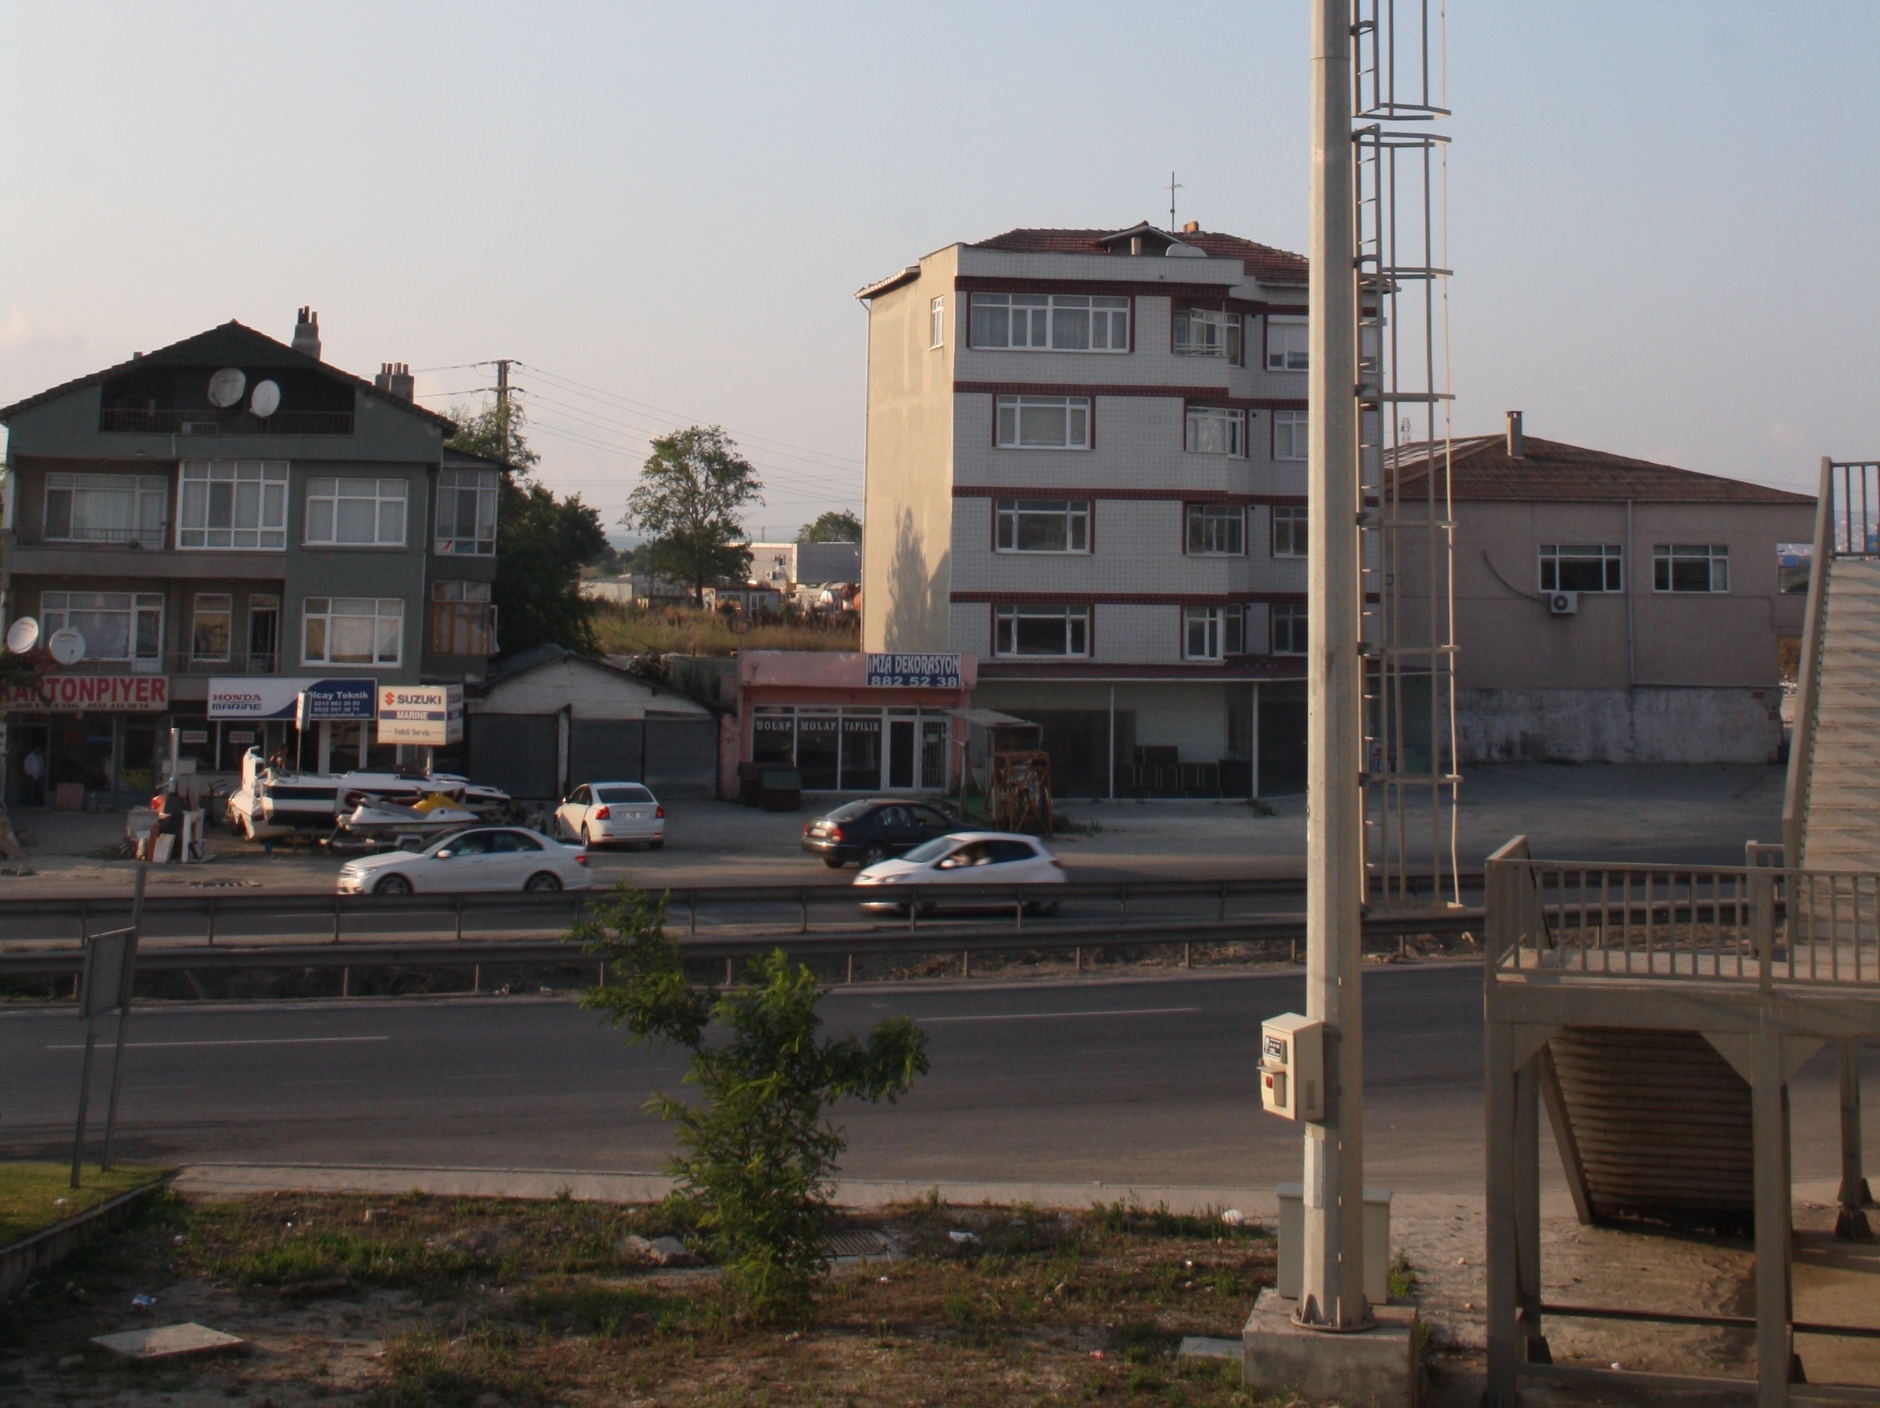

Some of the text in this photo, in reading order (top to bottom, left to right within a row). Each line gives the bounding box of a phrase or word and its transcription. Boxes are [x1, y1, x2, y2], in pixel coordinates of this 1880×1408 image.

[894, 655, 959, 675] DEKORASYON
[871, 676, 958, 687] 882 52 38
[310, 691, 369, 700] lcay Teknik
[397, 694, 442, 705] SUZUKI
[396, 711, 429, 720] MARINE
[756, 721, 792, 730] DOLAP
[800, 721, 837, 730] MOLAP
